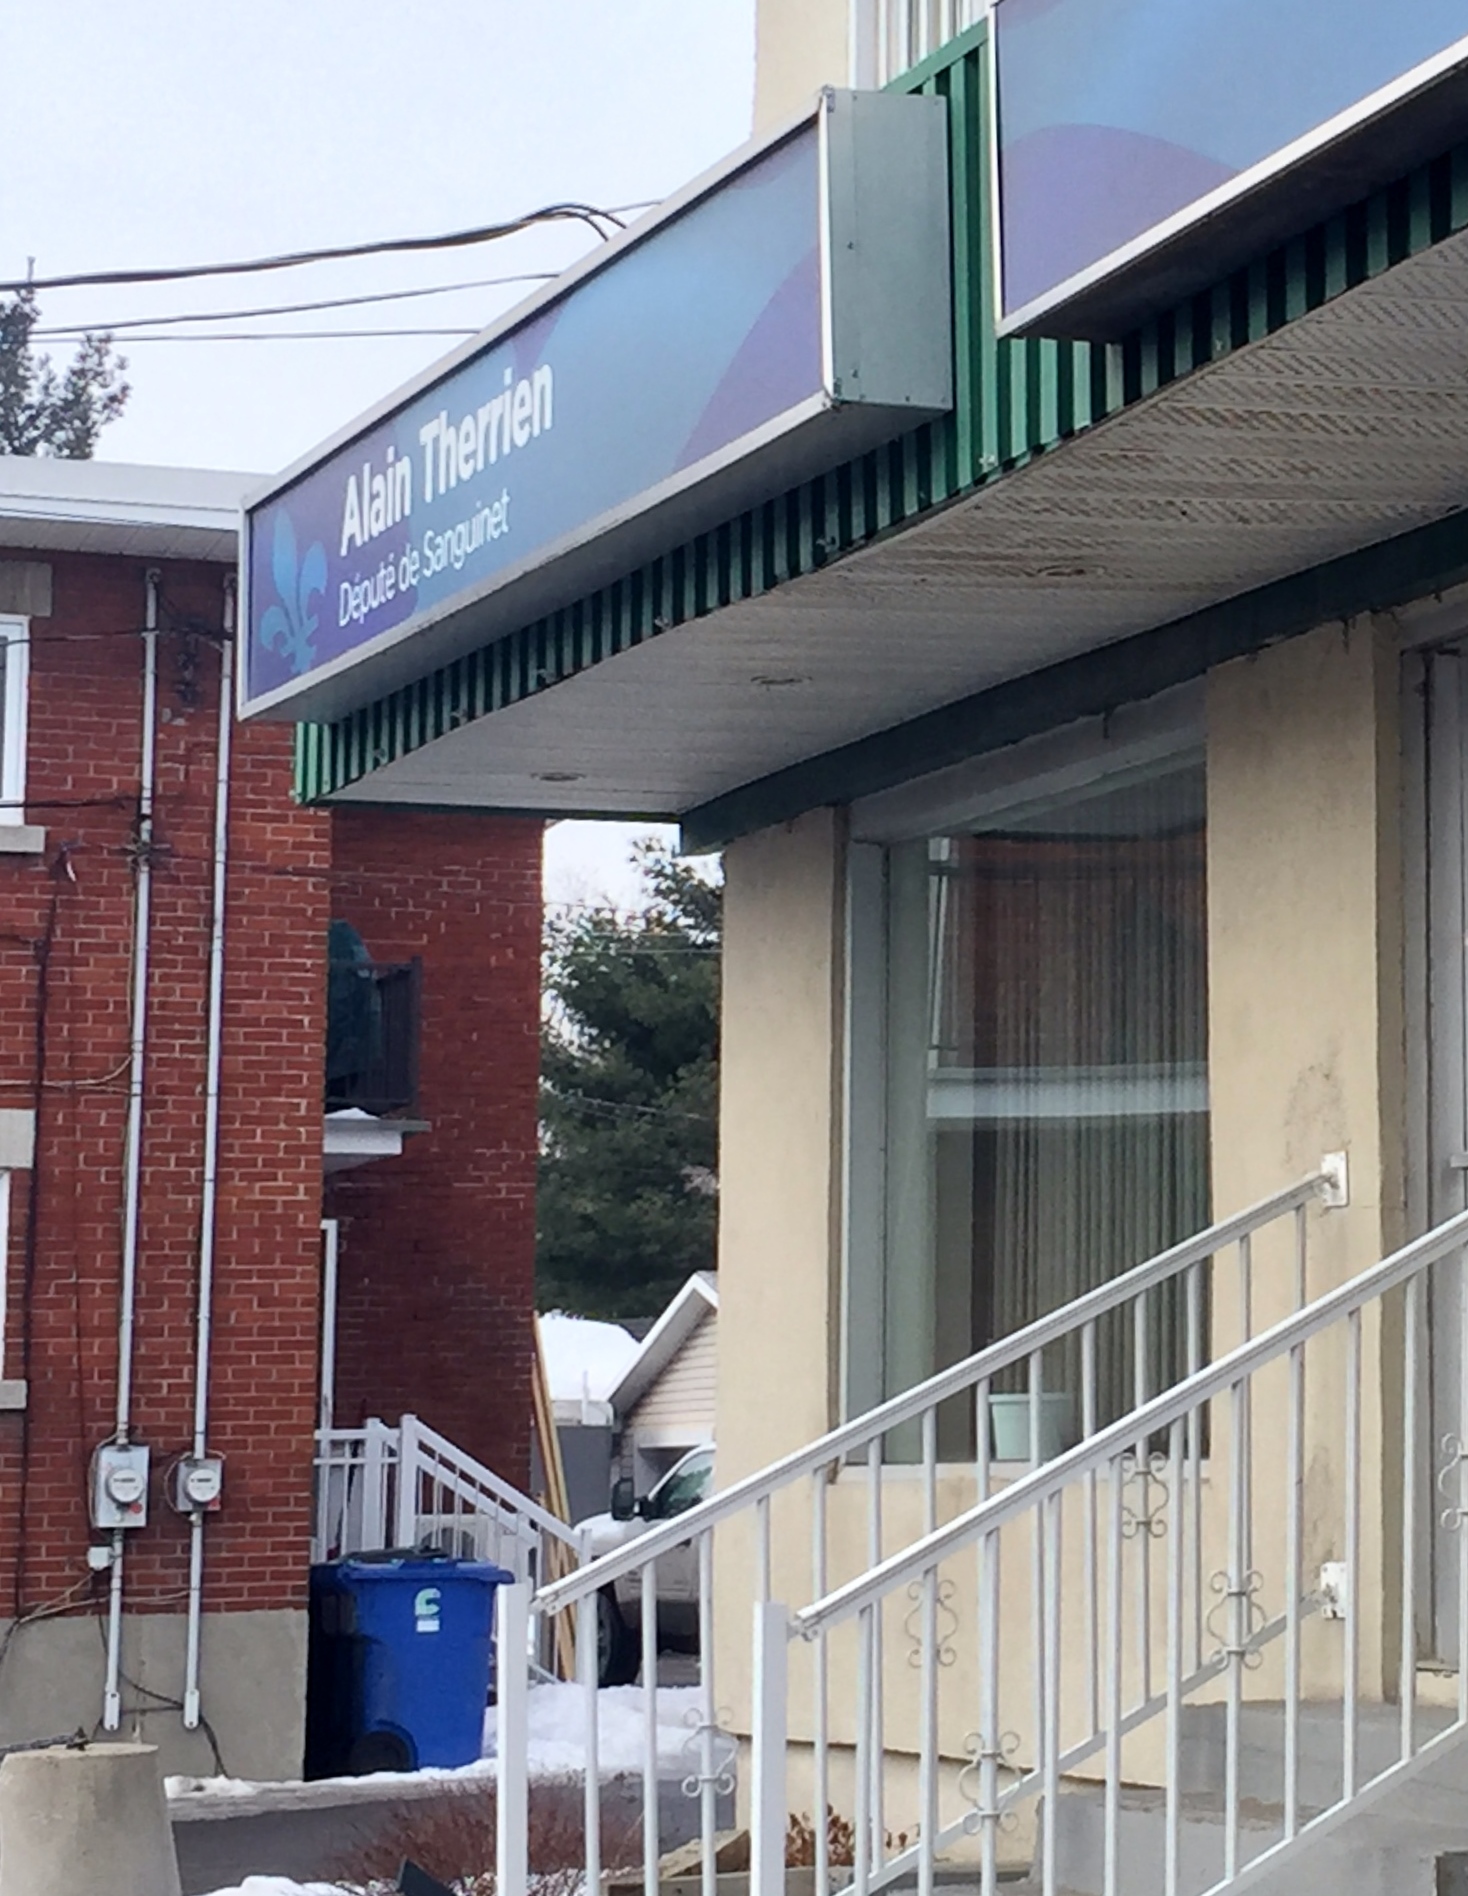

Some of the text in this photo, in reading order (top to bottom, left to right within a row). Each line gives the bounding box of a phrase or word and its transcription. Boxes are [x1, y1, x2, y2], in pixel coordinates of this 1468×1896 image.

[340, 364, 553, 557] Alain Therrien
[338, 487, 511, 627] Député de Sanguinet
